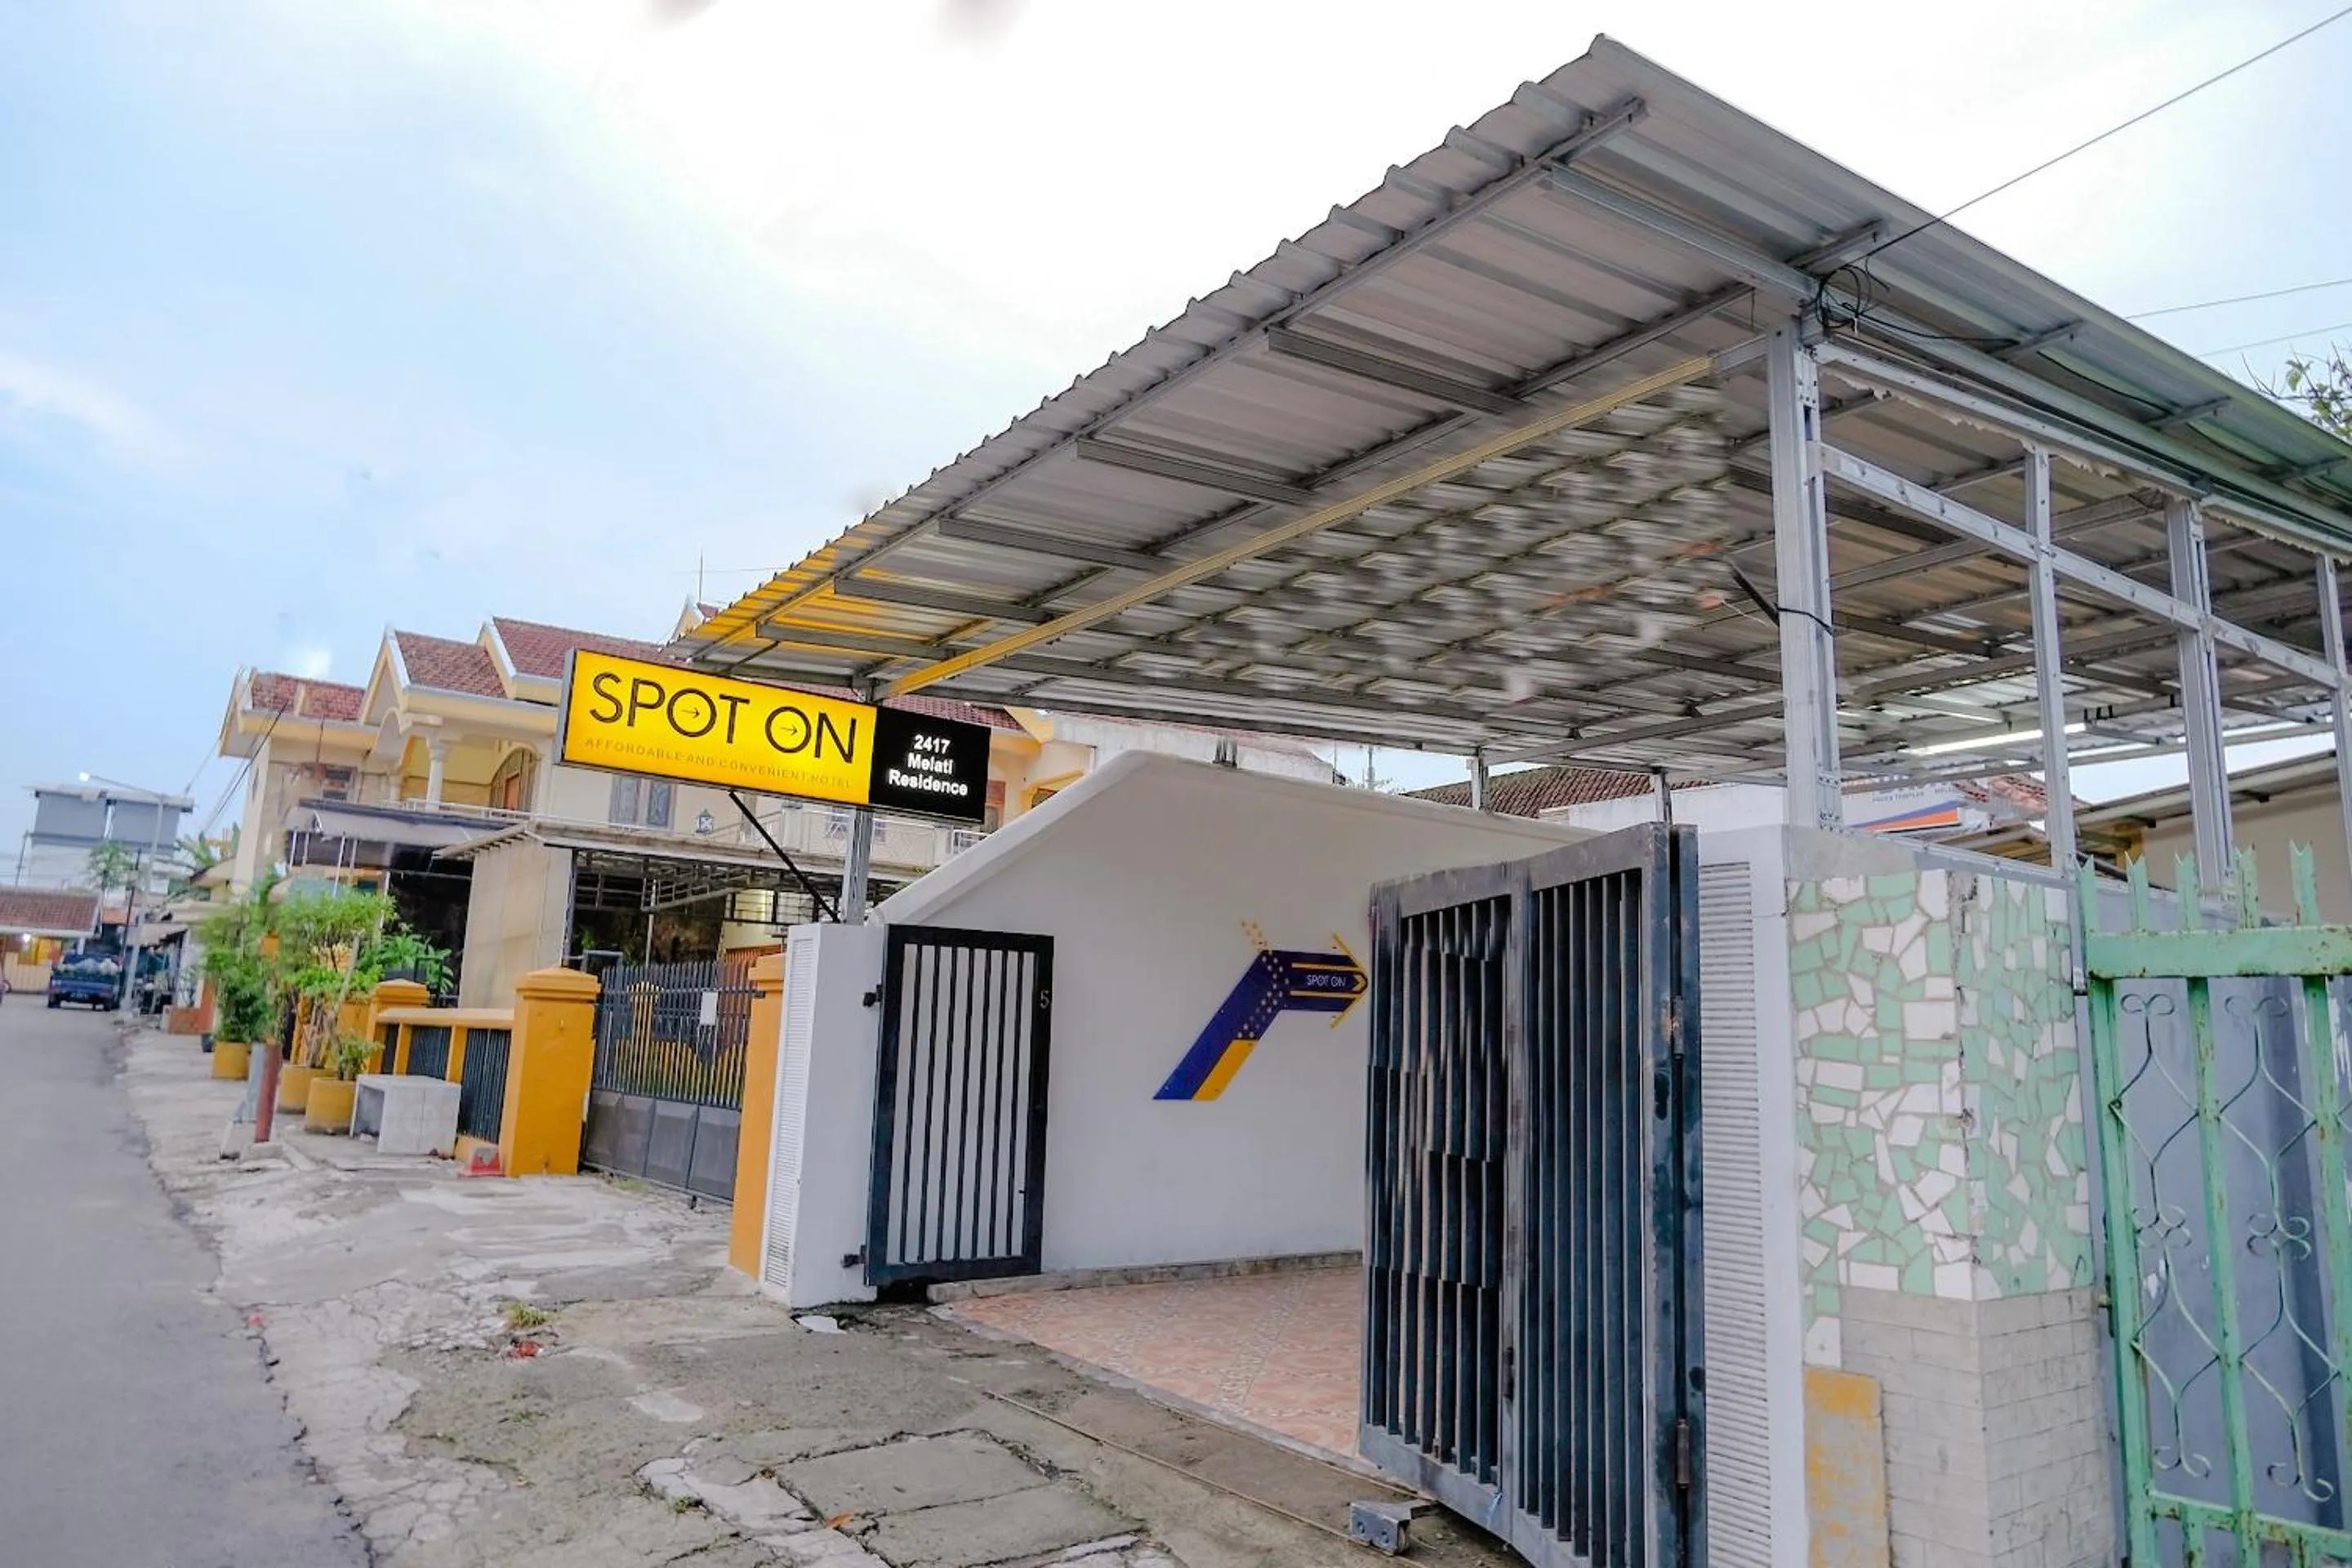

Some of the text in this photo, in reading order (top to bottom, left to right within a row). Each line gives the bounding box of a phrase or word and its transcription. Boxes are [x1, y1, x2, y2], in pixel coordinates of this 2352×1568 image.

[590, 672, 857, 764] SPOT ON
[914, 733, 951, 755] 2417
[585, 737, 684, 760] AFFORDABLE
[687, 753, 714, 766] AND
[719, 759, 806, 782] CONVENIENT
[907, 752, 953, 775] Melati
[889, 768, 968, 796] Residence
[1306, 974, 1347, 987] SPOT ON
